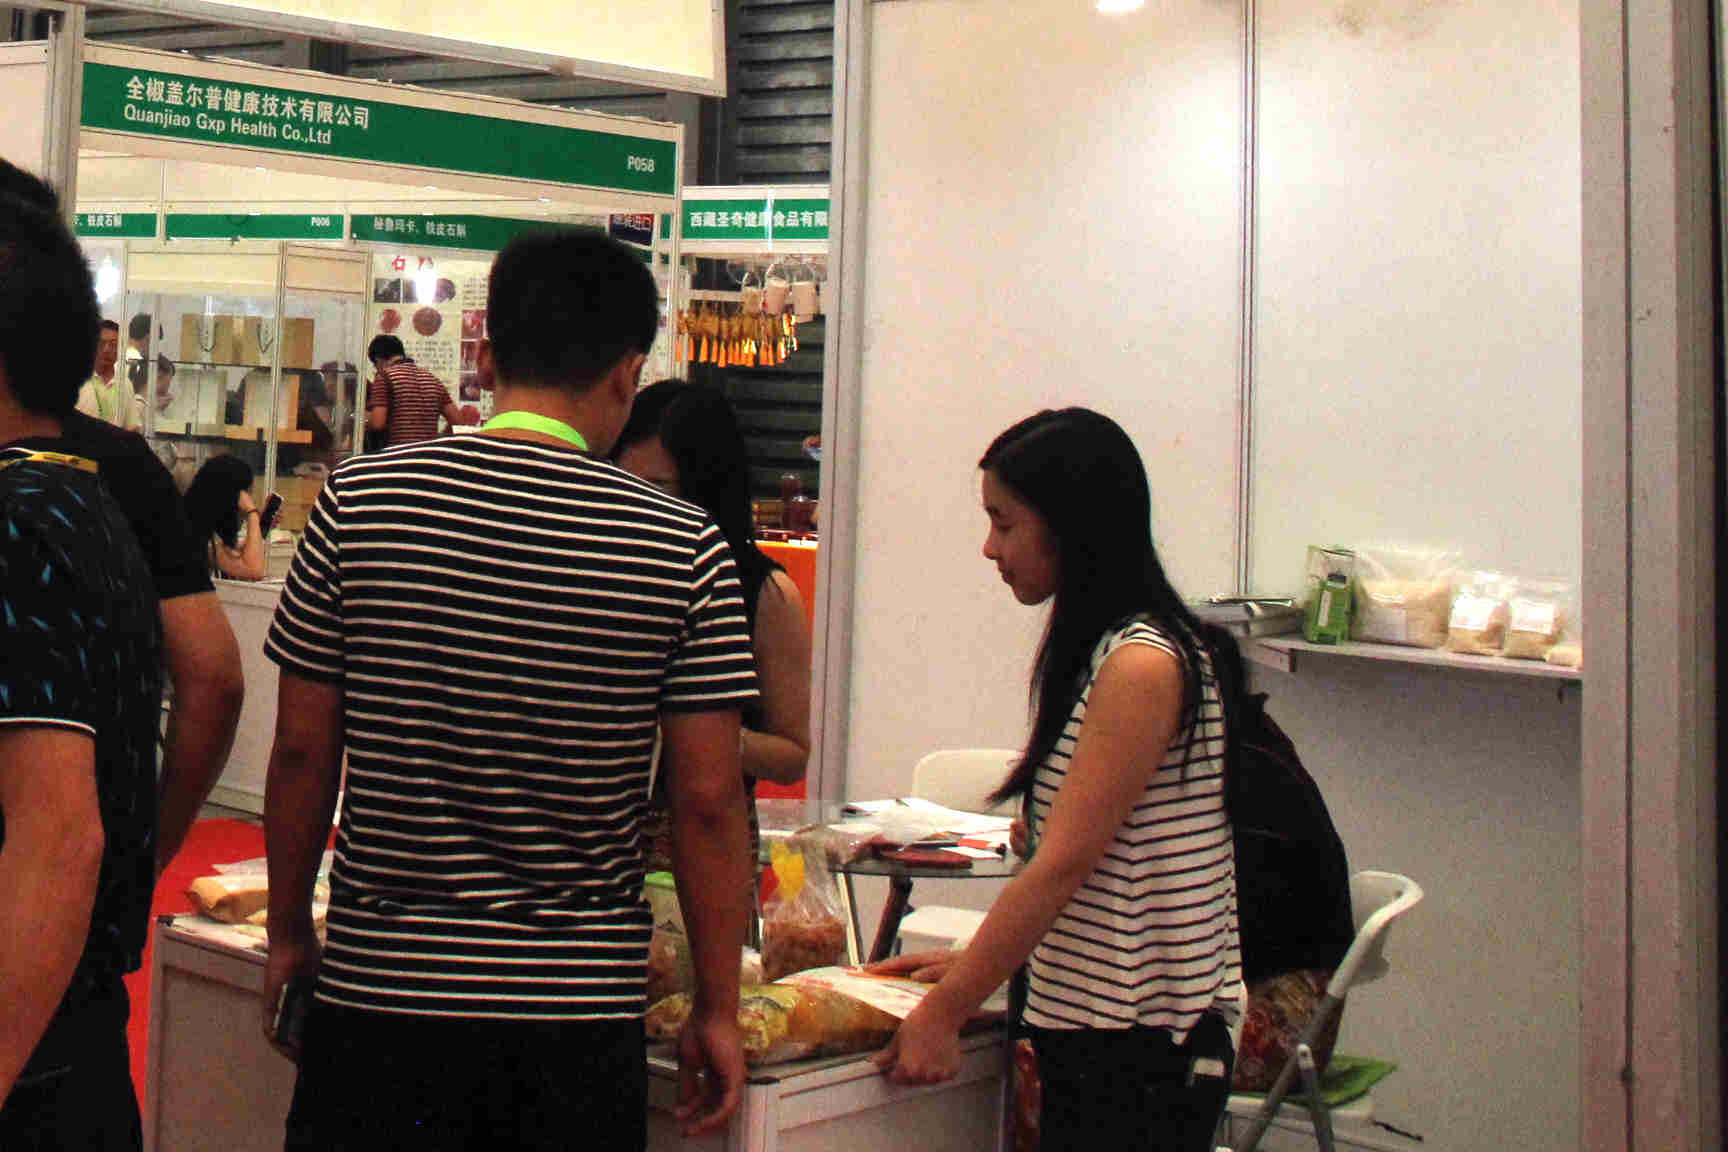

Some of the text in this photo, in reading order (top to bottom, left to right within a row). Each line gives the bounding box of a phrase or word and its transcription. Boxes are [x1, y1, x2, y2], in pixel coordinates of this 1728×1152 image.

[123, 103, 332, 146] Quanjiao Gxp Health Co.,Ltd
[125, 75, 370, 130] 全椒盖尔普健康技术有限公司
